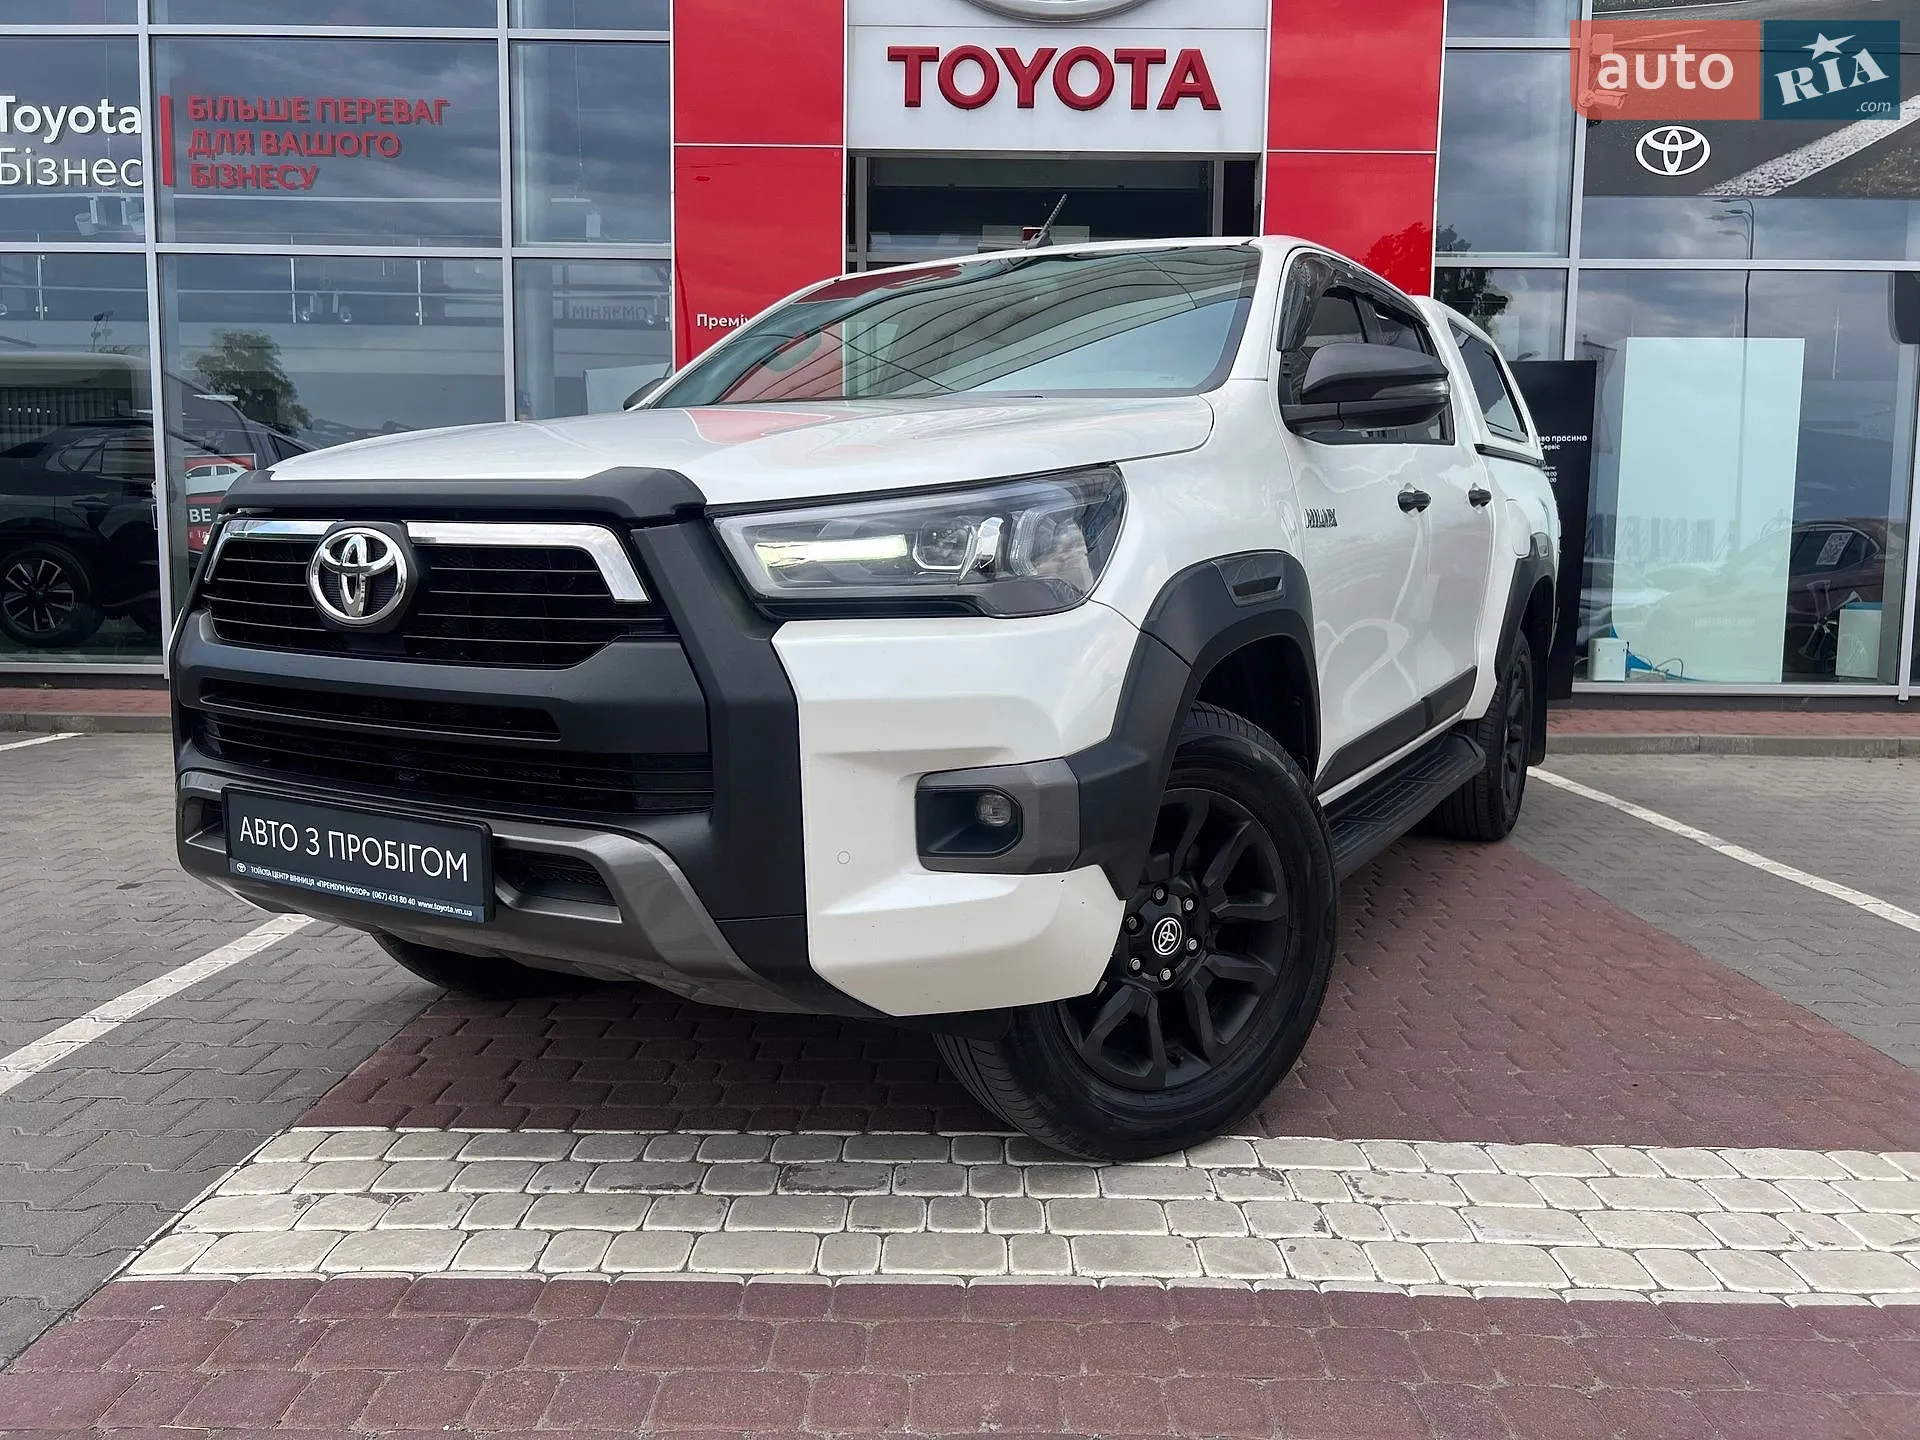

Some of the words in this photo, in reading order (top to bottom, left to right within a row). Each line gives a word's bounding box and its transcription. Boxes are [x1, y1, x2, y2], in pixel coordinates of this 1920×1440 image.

[887, 44, 1222, 112] TOYOTA
[0, 95, 142, 144] Toyota
[187, 95, 310, 123] БІЛЬШЕ
[315, 97, 450, 125] ПЕРЕВАГ
[188, 127, 255, 158] ДЛЯ
[260, 130, 401, 157] ВАШОГО
[0, 147, 143, 187] Бізнес
[190, 162, 317, 190] БІЗНЕСУ
[239, 816, 299, 852] АВТО
[327, 830, 468, 882] ПРОБІГОМ
[250, 865, 272, 877] ТОЙОТА
[271, 870, 290, 880] ЦЕНТР
[289, 873, 315, 886] ВІННИЦЯ
[372, 890, 388, 901] (067)
[388, 893, 399, 903] 431
[398, 895, 408, 905] 80
[407, 897, 416, 906] 40
[417, 899, 473, 917] www.toyota.vn.ua
